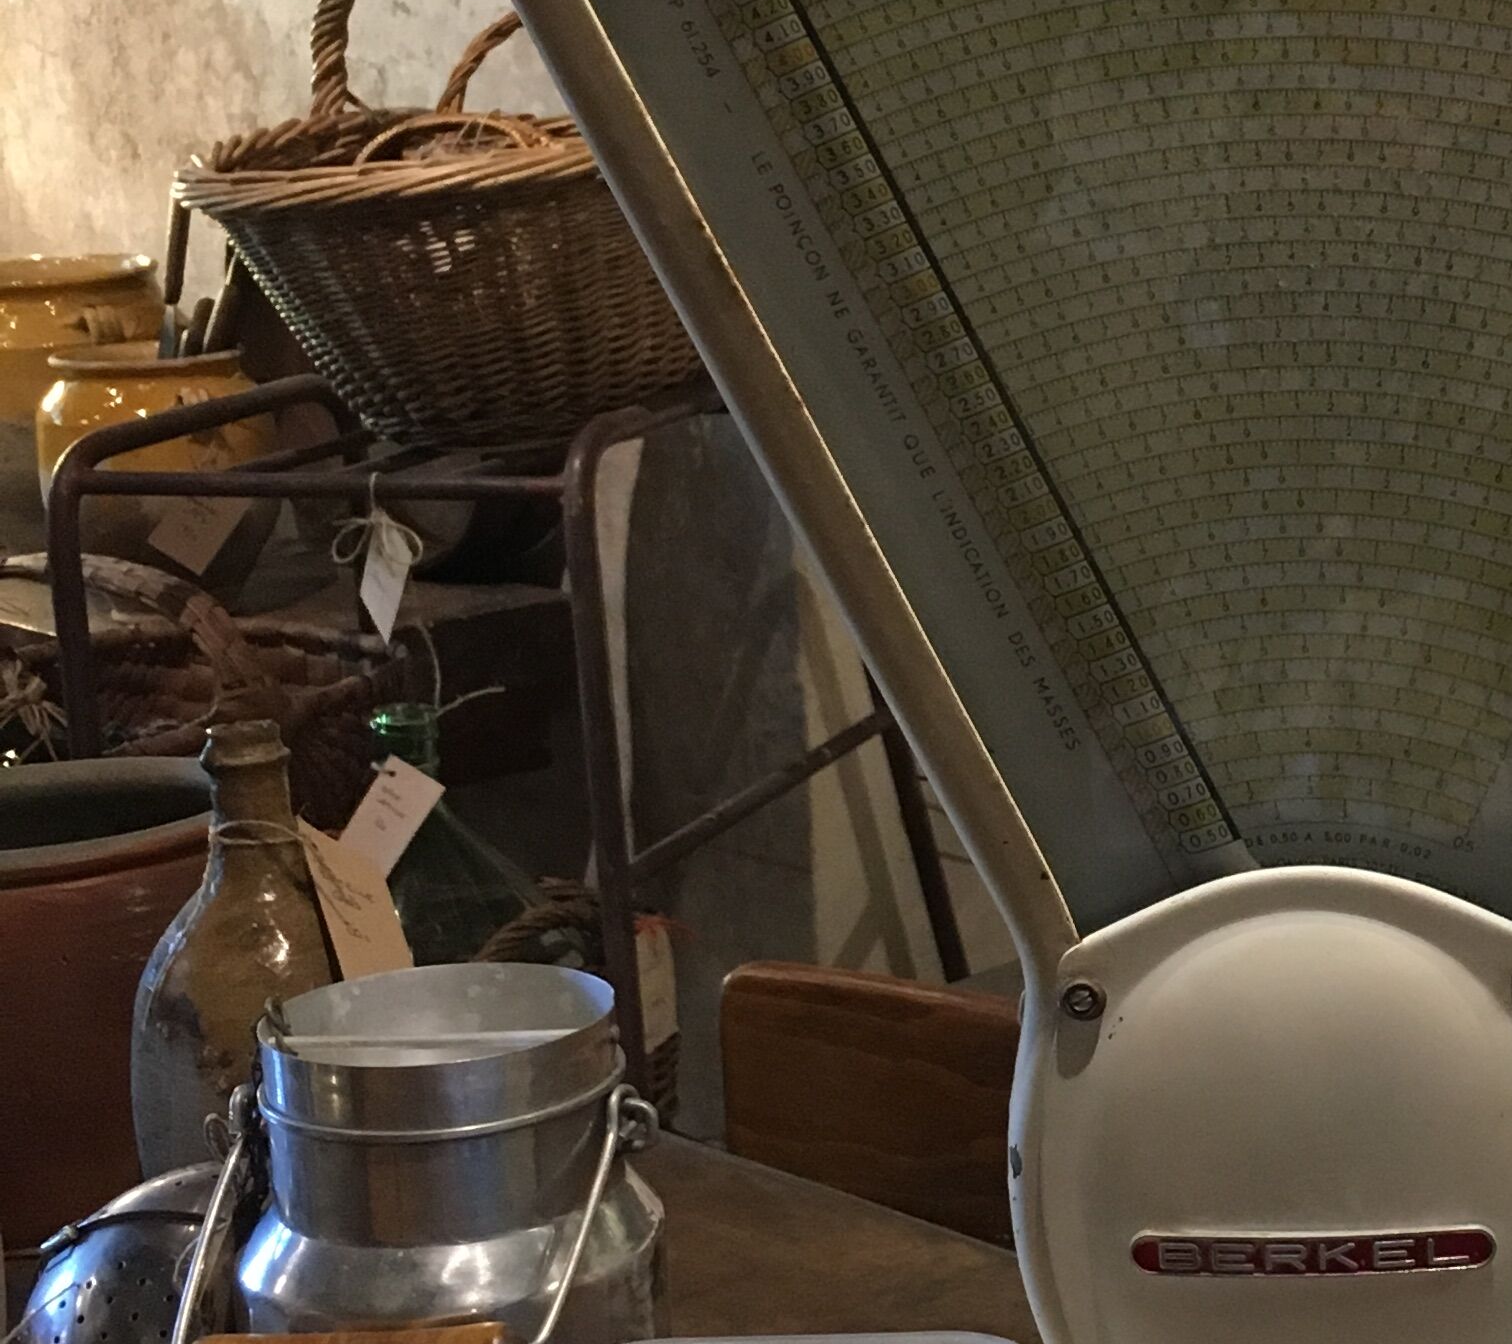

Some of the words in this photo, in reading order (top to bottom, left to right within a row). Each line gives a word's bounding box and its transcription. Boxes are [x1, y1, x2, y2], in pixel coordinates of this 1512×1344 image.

[753, 152, 772, 174] LE
[825, 291, 849, 319] NE
[844, 330, 907, 424] GARANTIT
[902, 434, 935, 478] QUE
[1009, 633, 1035, 667] DES
[1031, 678, 1081, 750] MASSES
[1157, 1238, 1470, 1273] BERKEL
